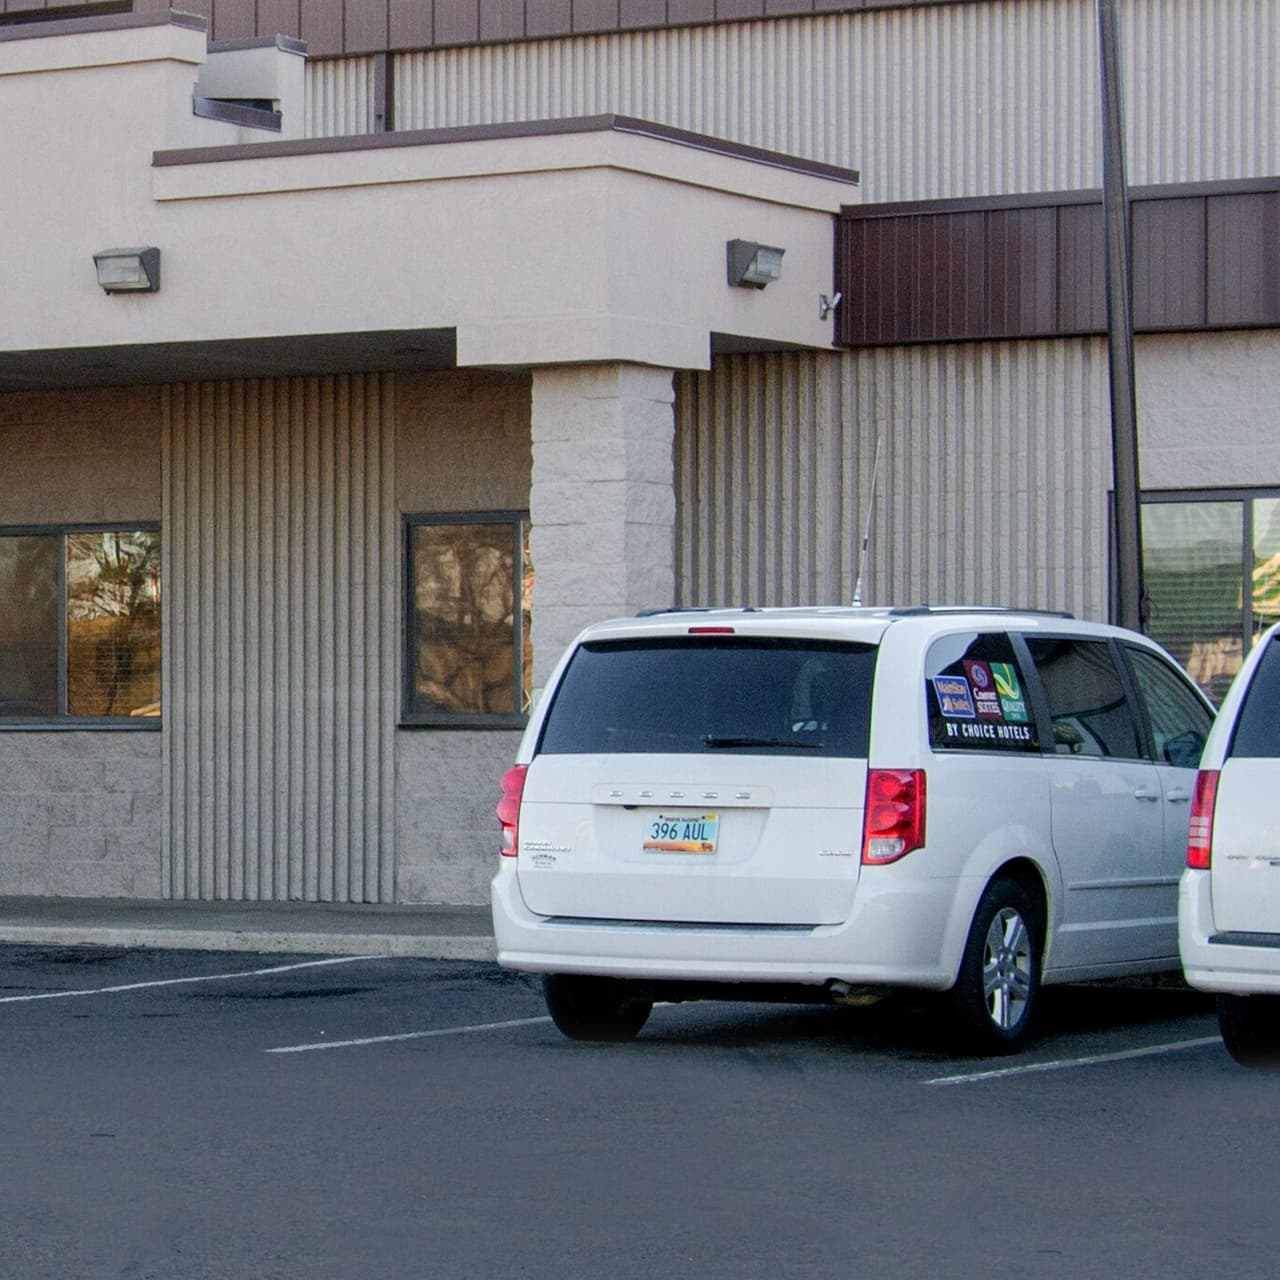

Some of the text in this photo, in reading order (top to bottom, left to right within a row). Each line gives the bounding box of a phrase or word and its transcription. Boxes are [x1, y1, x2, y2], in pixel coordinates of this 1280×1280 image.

[946, 723, 1030, 740] BY CHOICE HOTELS
[651, 822, 709, 840] 396 AUL
